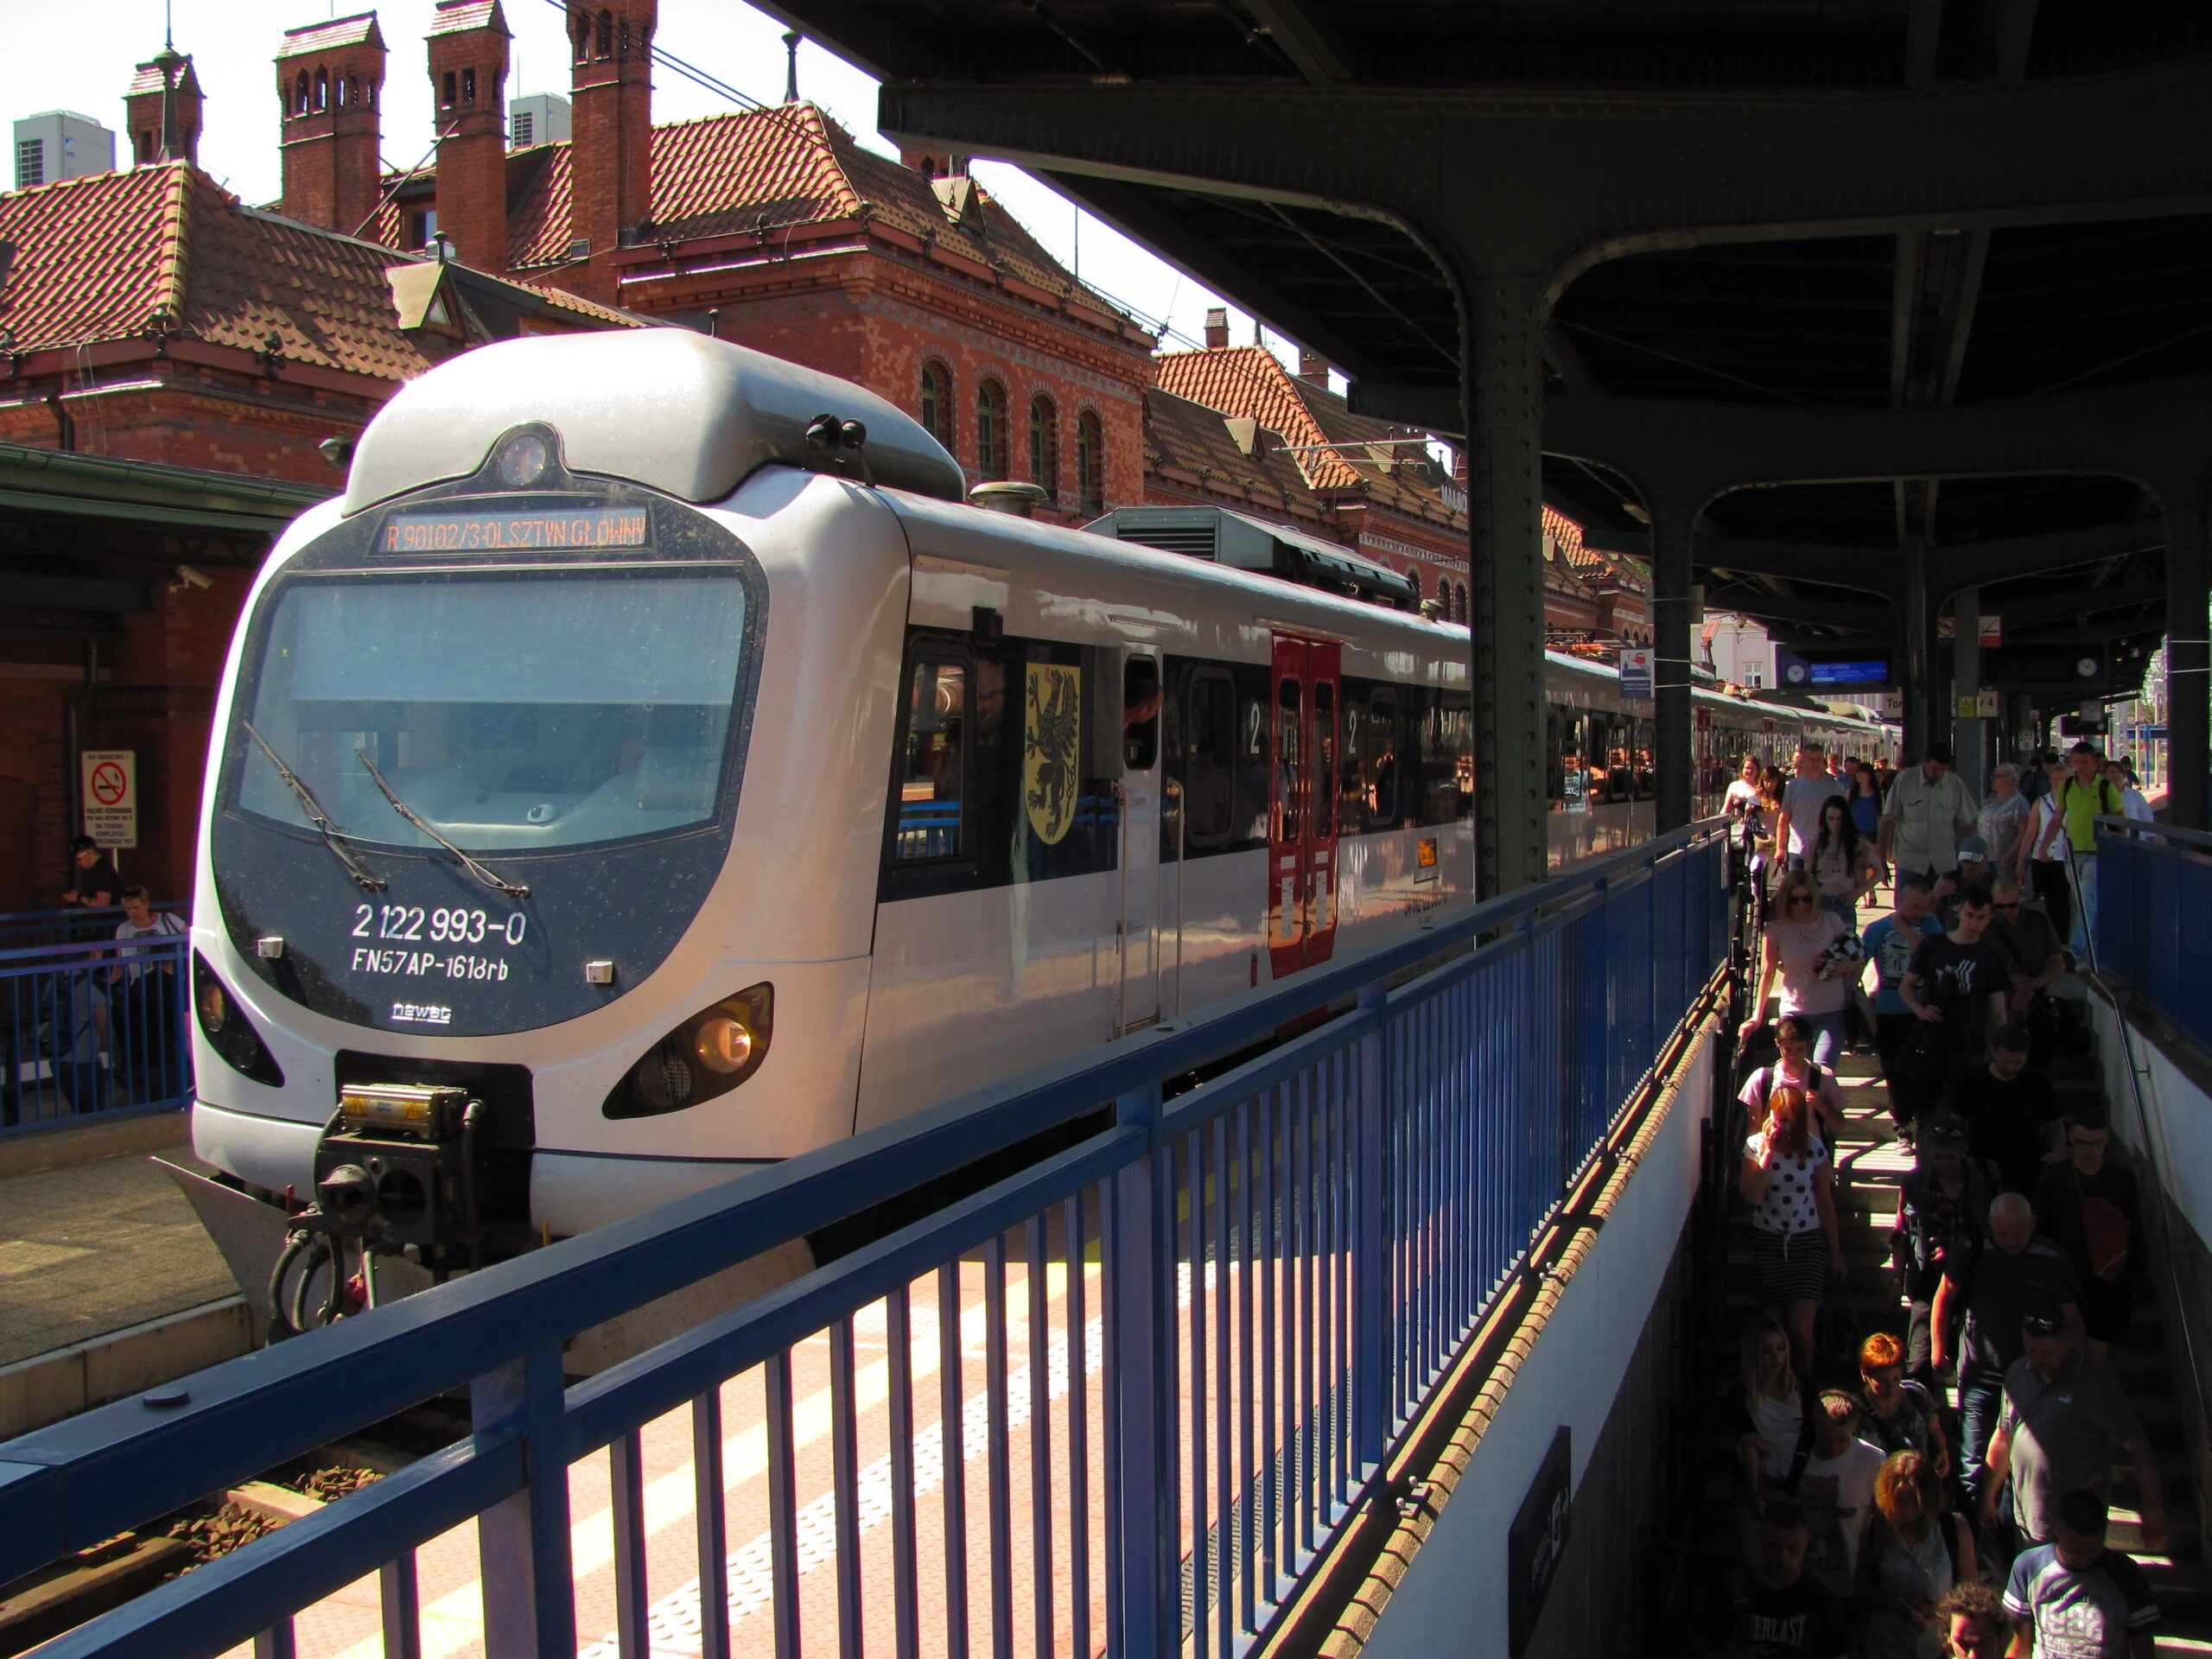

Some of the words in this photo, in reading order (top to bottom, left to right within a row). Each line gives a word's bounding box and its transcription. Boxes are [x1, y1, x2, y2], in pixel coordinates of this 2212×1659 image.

[1441, 485, 1468, 514] MALBO
[386, 525, 399, 551] R
[1987, 698, 1993, 708] 4
[1249, 702, 1261, 754] 2
[1348, 709, 1357, 754] 2
[352, 904, 374, 938] 2
[379, 905, 426, 941] 122
[429, 907, 527, 945] 993-0
[1751, 1614, 1808, 1649] ERLAST
